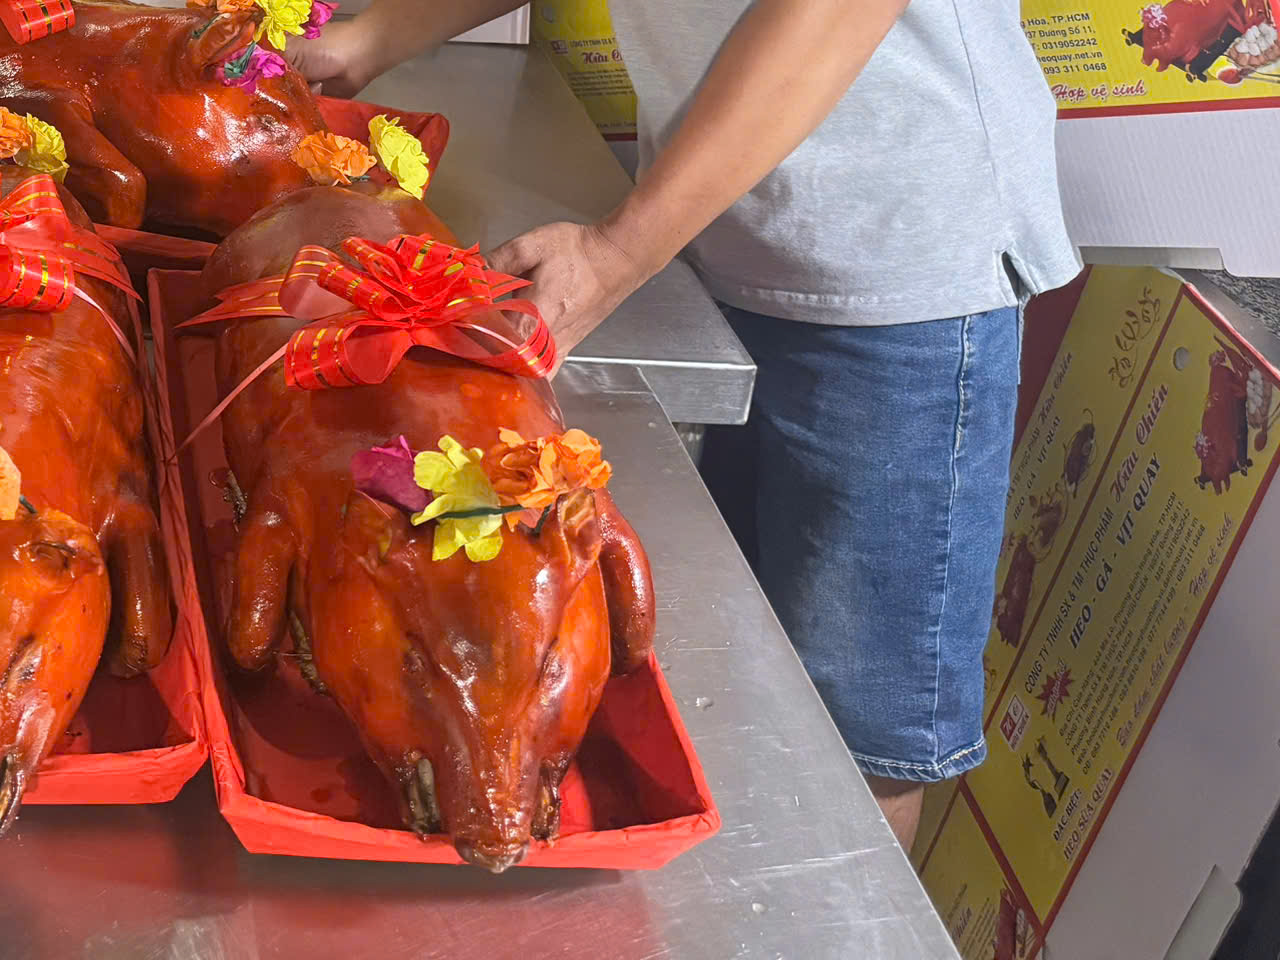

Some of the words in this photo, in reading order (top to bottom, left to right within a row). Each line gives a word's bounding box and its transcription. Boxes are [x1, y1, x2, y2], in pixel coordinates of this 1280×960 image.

[1042, 38, 1097, 50] 0319052242
[1044, 66, 1061, 75] 093
[1064, 64, 1080, 73] 311
[1083, 63, 1107, 72] 0468
